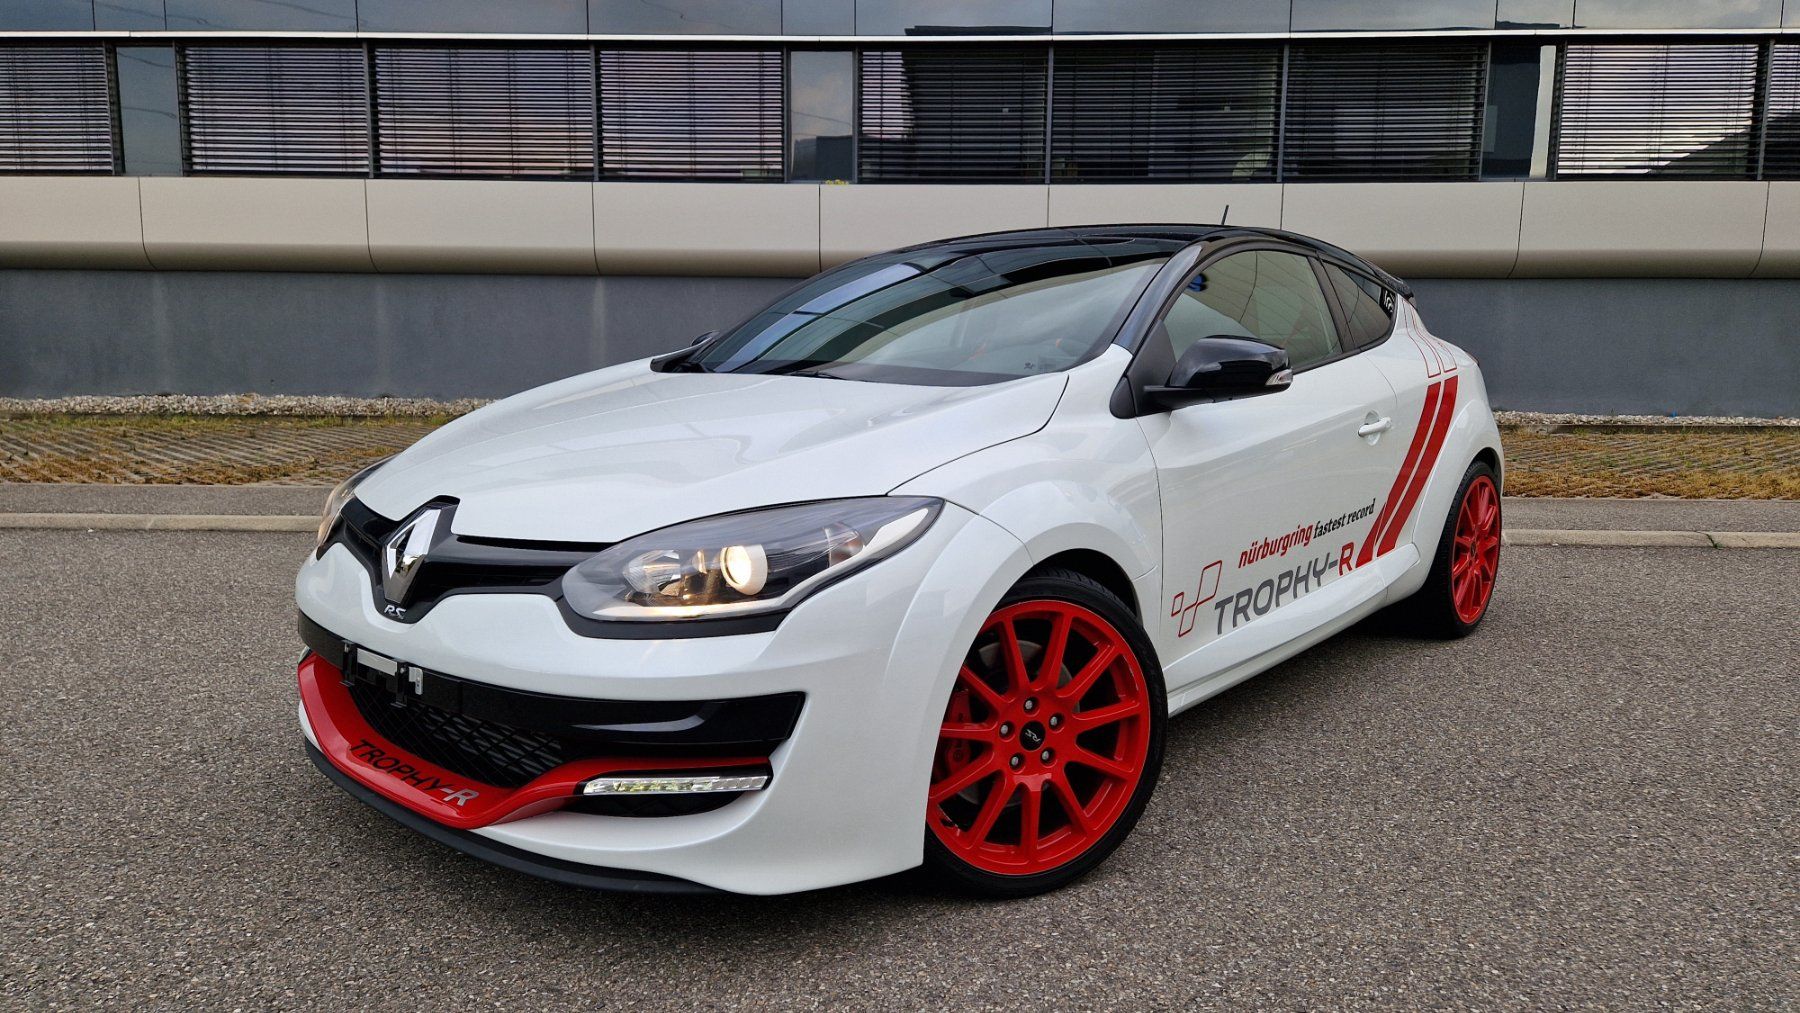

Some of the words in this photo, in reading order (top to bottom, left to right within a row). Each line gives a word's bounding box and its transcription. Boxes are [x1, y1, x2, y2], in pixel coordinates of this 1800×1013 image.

[1238, 524, 1313, 568] nürburgring
[1313, 513, 1346, 539] fastest
[1346, 498, 1376, 525] record
[1214, 541, 1355, 635] TROPHY-R
[350, 739, 479, 806] TROPHY-R
